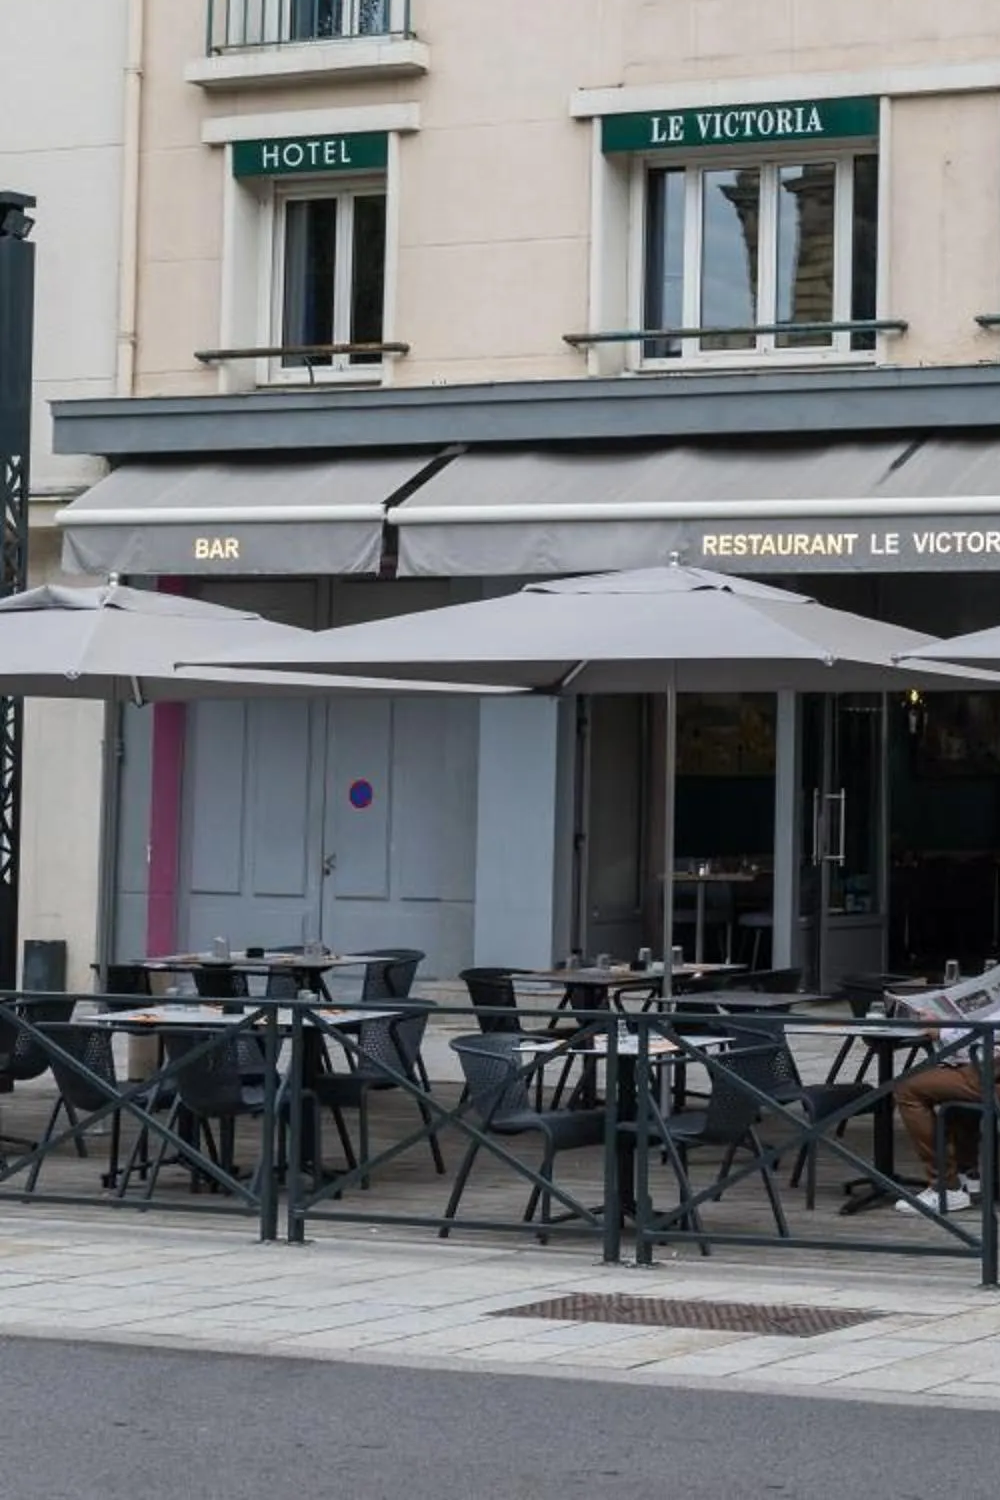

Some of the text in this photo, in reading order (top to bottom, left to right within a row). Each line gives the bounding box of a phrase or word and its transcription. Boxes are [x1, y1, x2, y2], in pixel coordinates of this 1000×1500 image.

[650, 107, 824, 143] LE VICTORIA
[262, 140, 352, 168] HOTEL
[194, 537, 241, 560] BAR
[702, 533, 859, 556] RESTAURANT
[870, 532, 900, 554] LE
